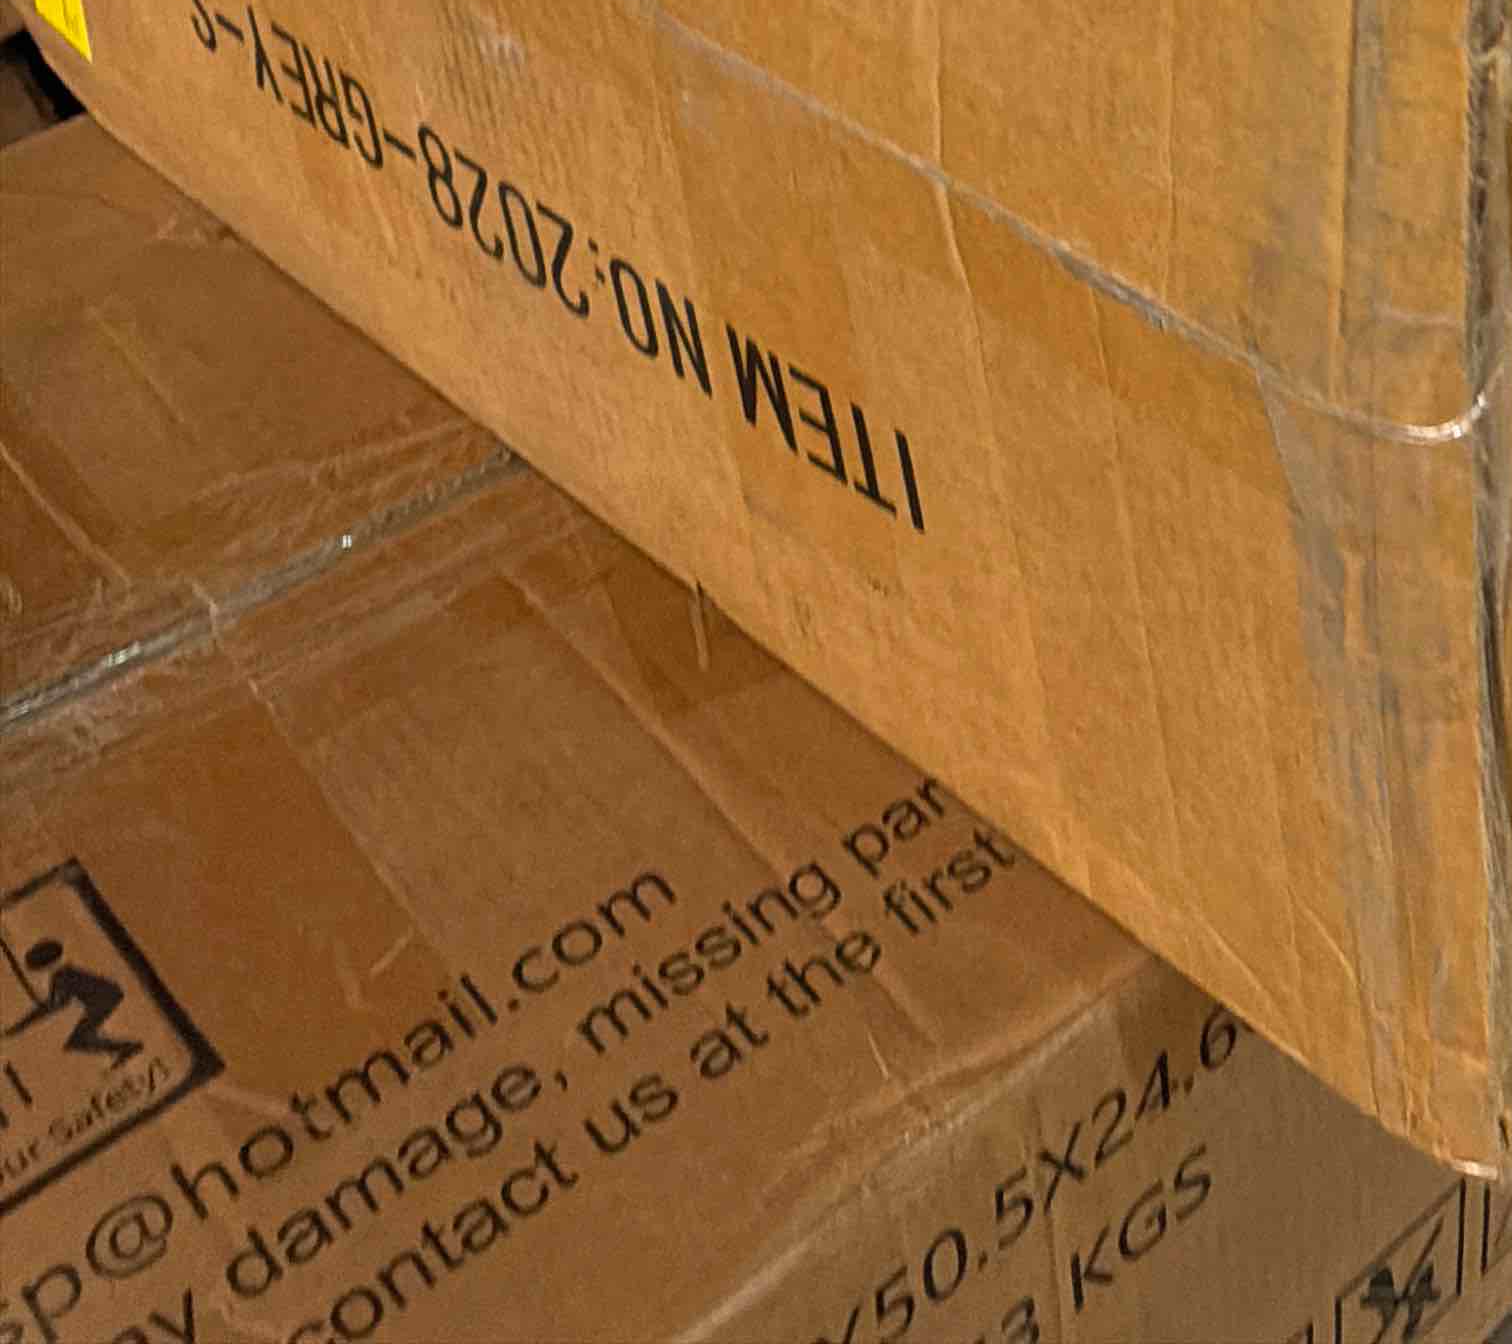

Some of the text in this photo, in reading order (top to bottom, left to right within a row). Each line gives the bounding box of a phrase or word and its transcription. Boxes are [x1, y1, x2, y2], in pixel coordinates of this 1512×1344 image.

[726, 321, 928, 534] ITEM
[225, 1058, 569, 1299] damage,
[576, 860, 842, 1055] missing
[587, 1067, 679, 1154] us
[689, 1003, 771, 1080] at
[766, 925, 883, 1023] the
[882, 826, 1016, 937] first
[1070, 1145, 1213, 1312] KGS
